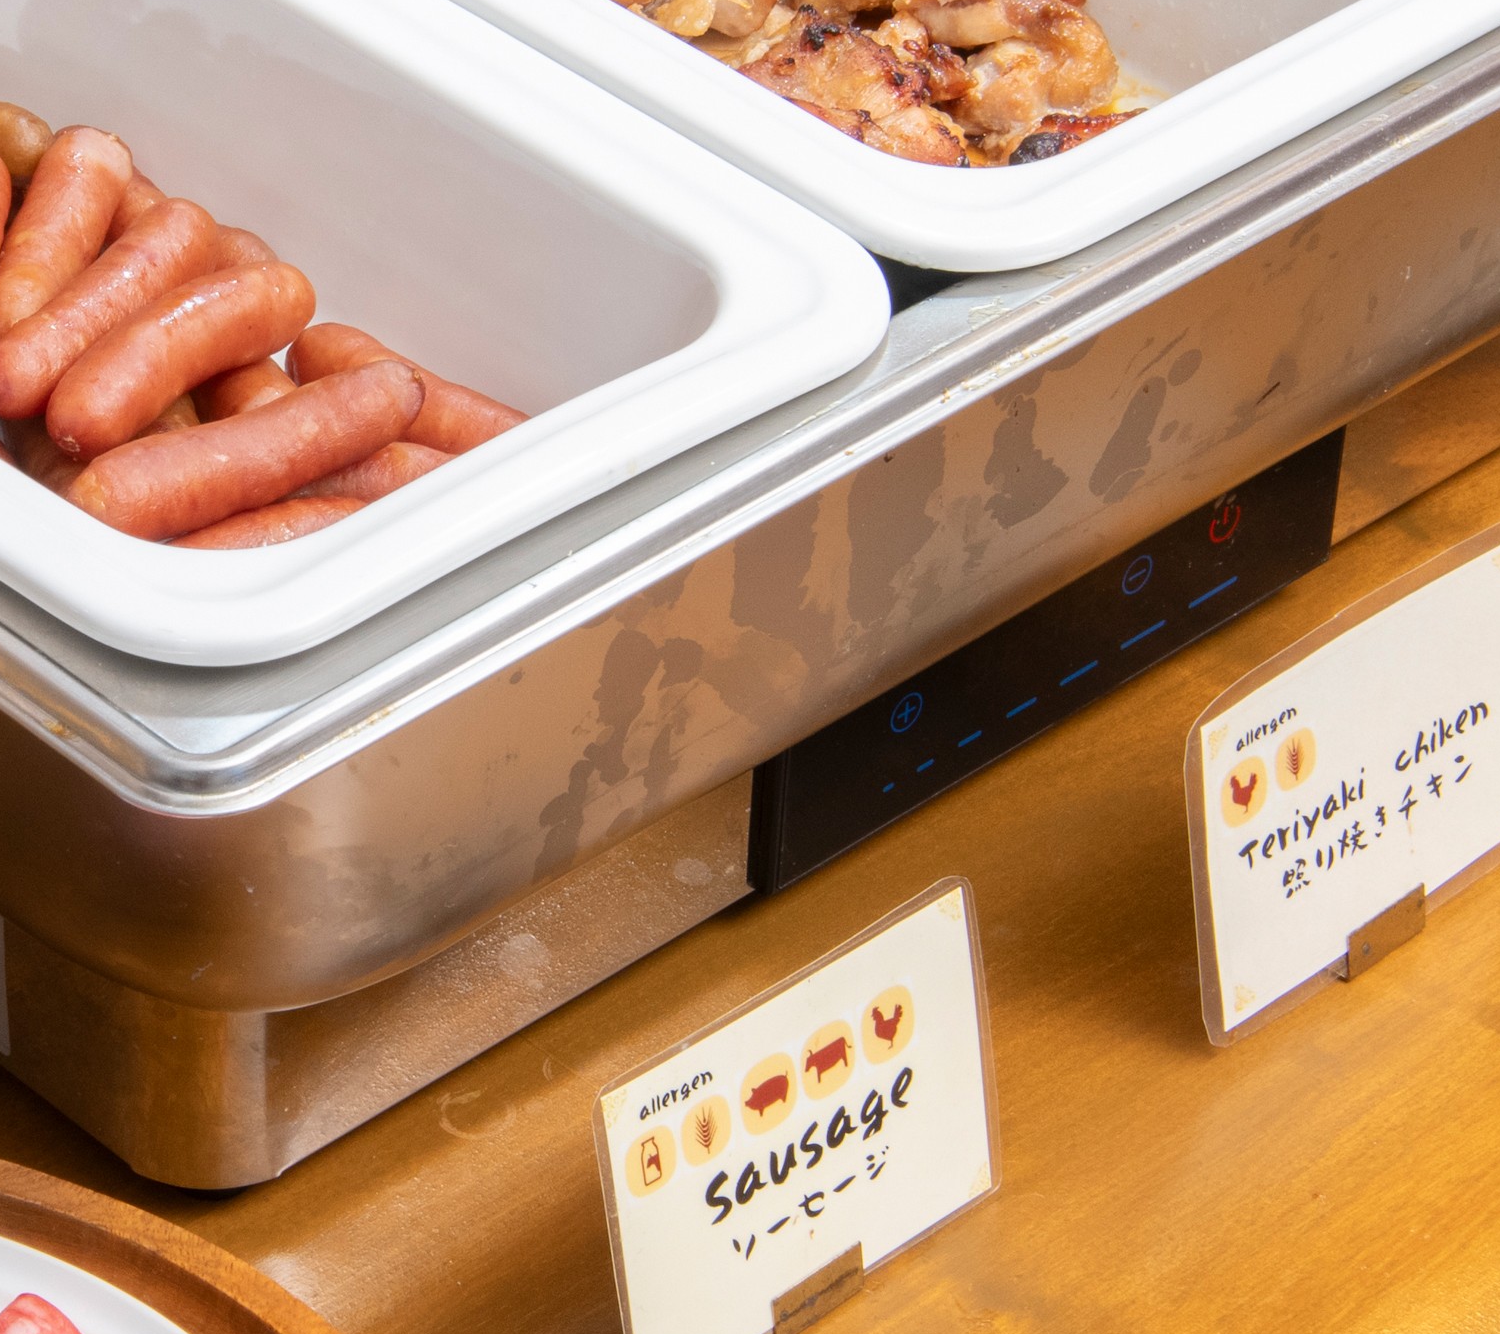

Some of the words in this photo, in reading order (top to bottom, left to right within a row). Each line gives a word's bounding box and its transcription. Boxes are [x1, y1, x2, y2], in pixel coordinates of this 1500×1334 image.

[1236, 706, 1299, 753] allergen
[1237, 767, 1366, 870] Teriyaki
[1394, 701, 1489, 772] chiken
[1281, 754, 1474, 900] 照り焼きチキン
[639, 1070, 713, 1120] allergen
[732, 1145, 889, 1261] ソーセージ
